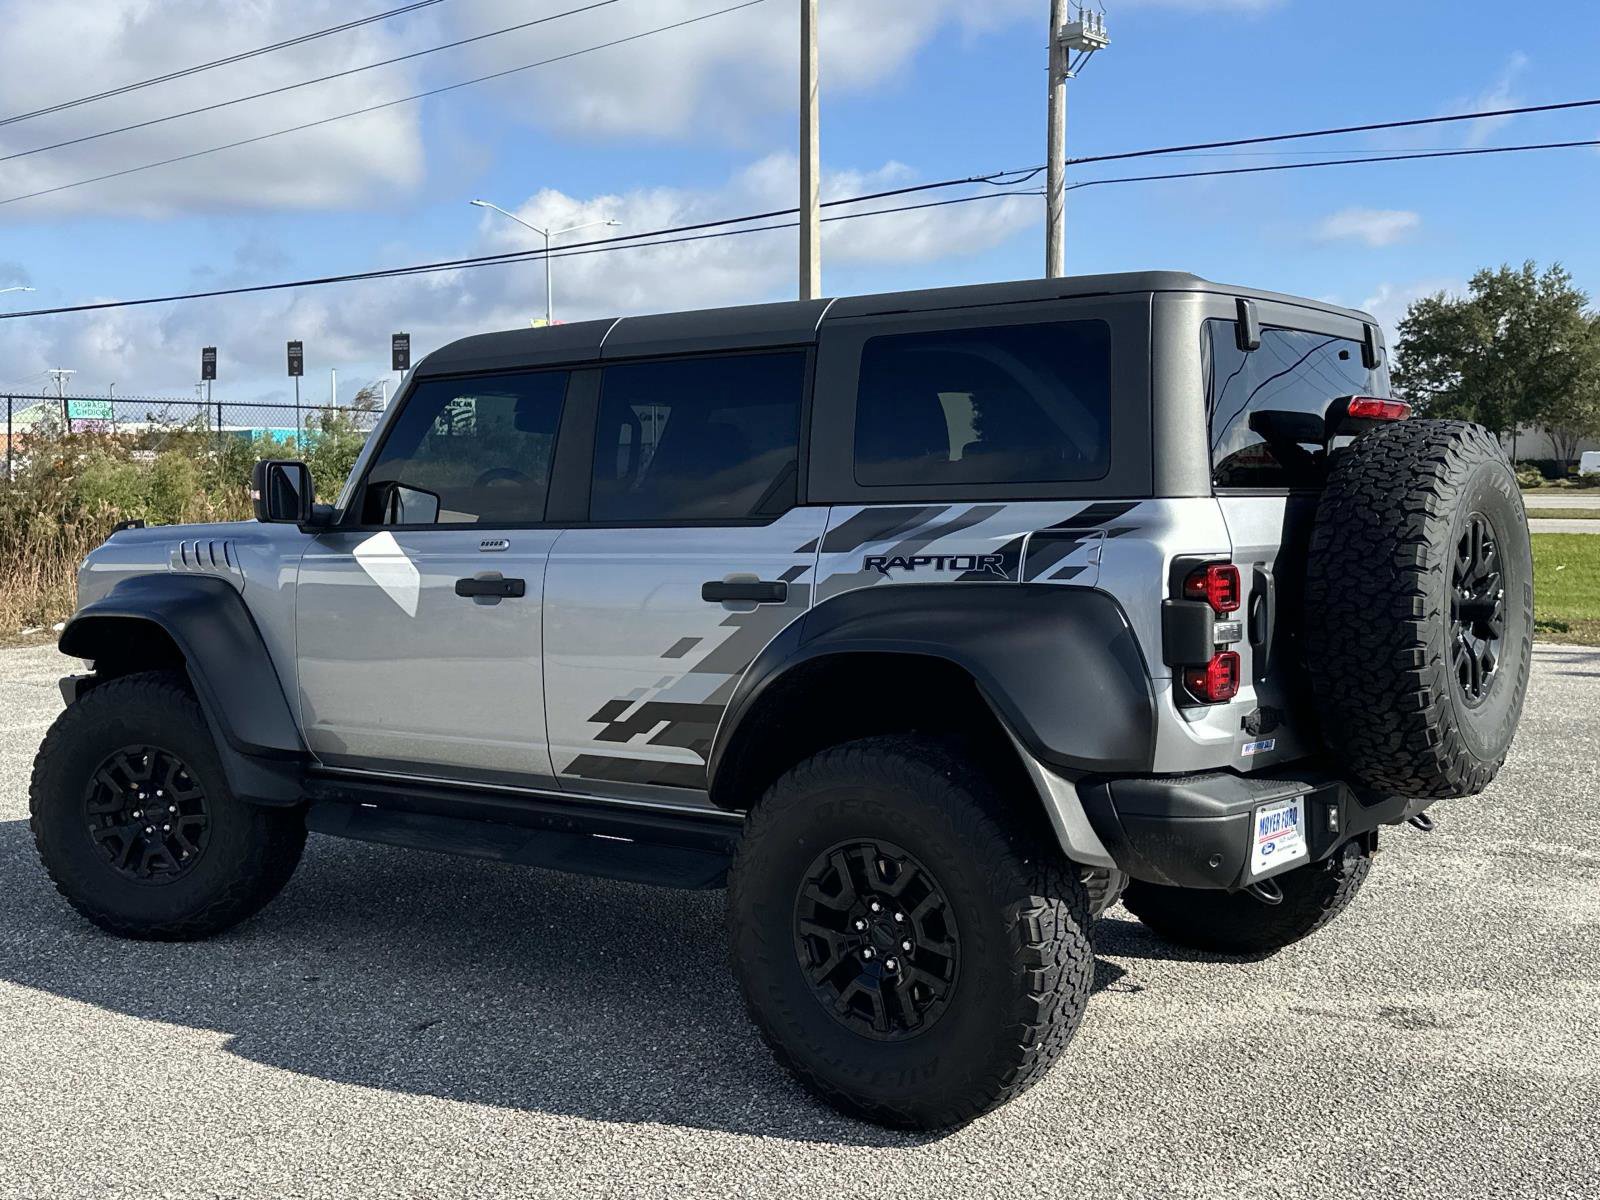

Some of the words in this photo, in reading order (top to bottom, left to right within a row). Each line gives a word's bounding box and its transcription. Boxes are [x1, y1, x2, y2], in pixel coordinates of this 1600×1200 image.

[73, 401, 108, 409] STORAGE
[864, 554, 1009, 581] RAPTOR
[1259, 812, 1281, 837] MOYER
[1281, 806, 1298, 830] FORD
